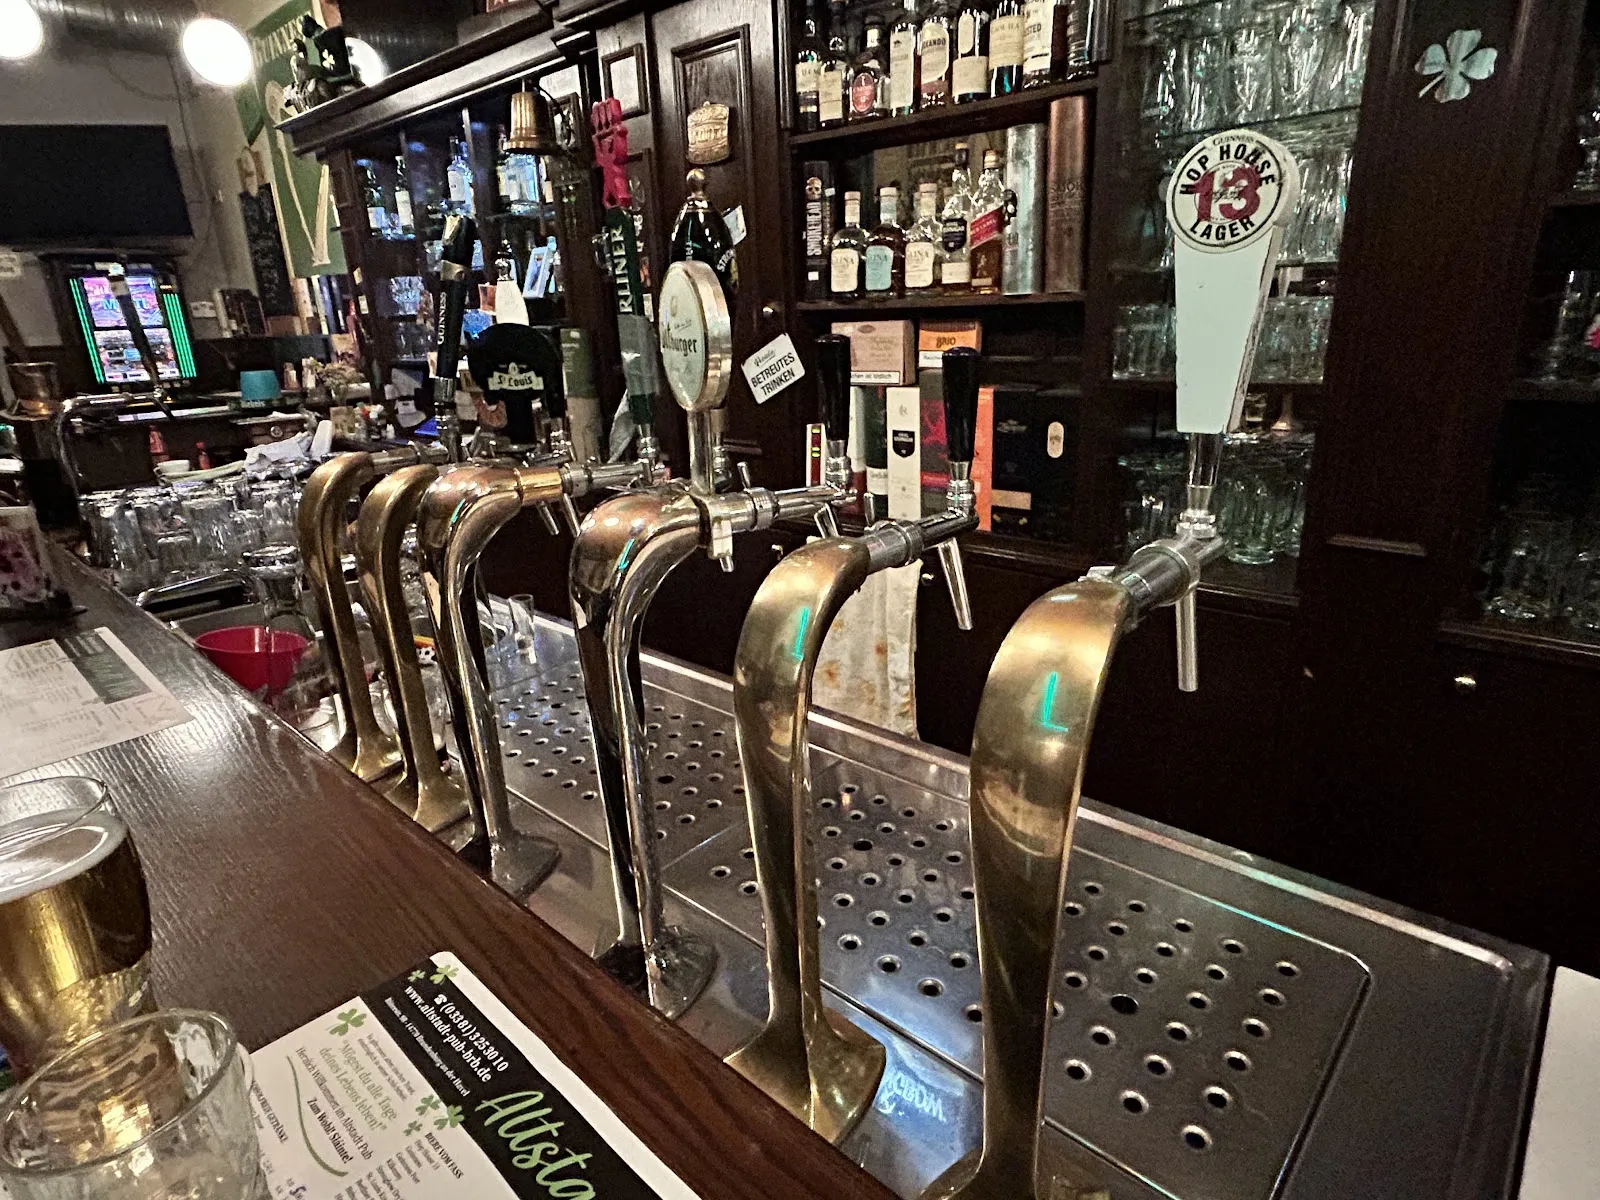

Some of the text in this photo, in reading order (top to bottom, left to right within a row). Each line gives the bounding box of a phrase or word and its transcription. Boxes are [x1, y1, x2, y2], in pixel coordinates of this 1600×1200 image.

[1179, 144, 1275, 194] HOP HOUSE
[1192, 167, 1261, 222] 13
[807, 202, 822, 256] SMOKEHEAD
[1190, 216, 1255, 240] LAGER
[437, 292, 447, 344] GUINNESS
[508, 376, 532, 386] Louis
[751, 352, 795, 387] BETREUTES
[761, 368, 795, 395] TRINKEN
[405, 986, 492, 1083] www.altstadt-pub-brb.de
[311, 1070, 340, 1109] Willkommen
[319, 1047, 340, 1072] deines
[334, 1070, 361, 1102] Lebens
[445, 1067, 456, 1080] der
[453, 1074, 471, 1097] Havel
[335, 1106, 346, 1118] im
[359, 1072, 371, 1085] du
[367, 1084, 383, 1099] alle
[378, 1096, 397, 1120] Tage
[307, 1097, 321, 1114] Zum
[316, 1111, 336, 1132] Wohl!
[329, 1130, 354, 1163] Sláinte!
[340, 1115, 364, 1144] Altstadt
[357, 1142, 372, 1160] Pub
[425, 1132, 464, 1178] BIERE VOM FASS
